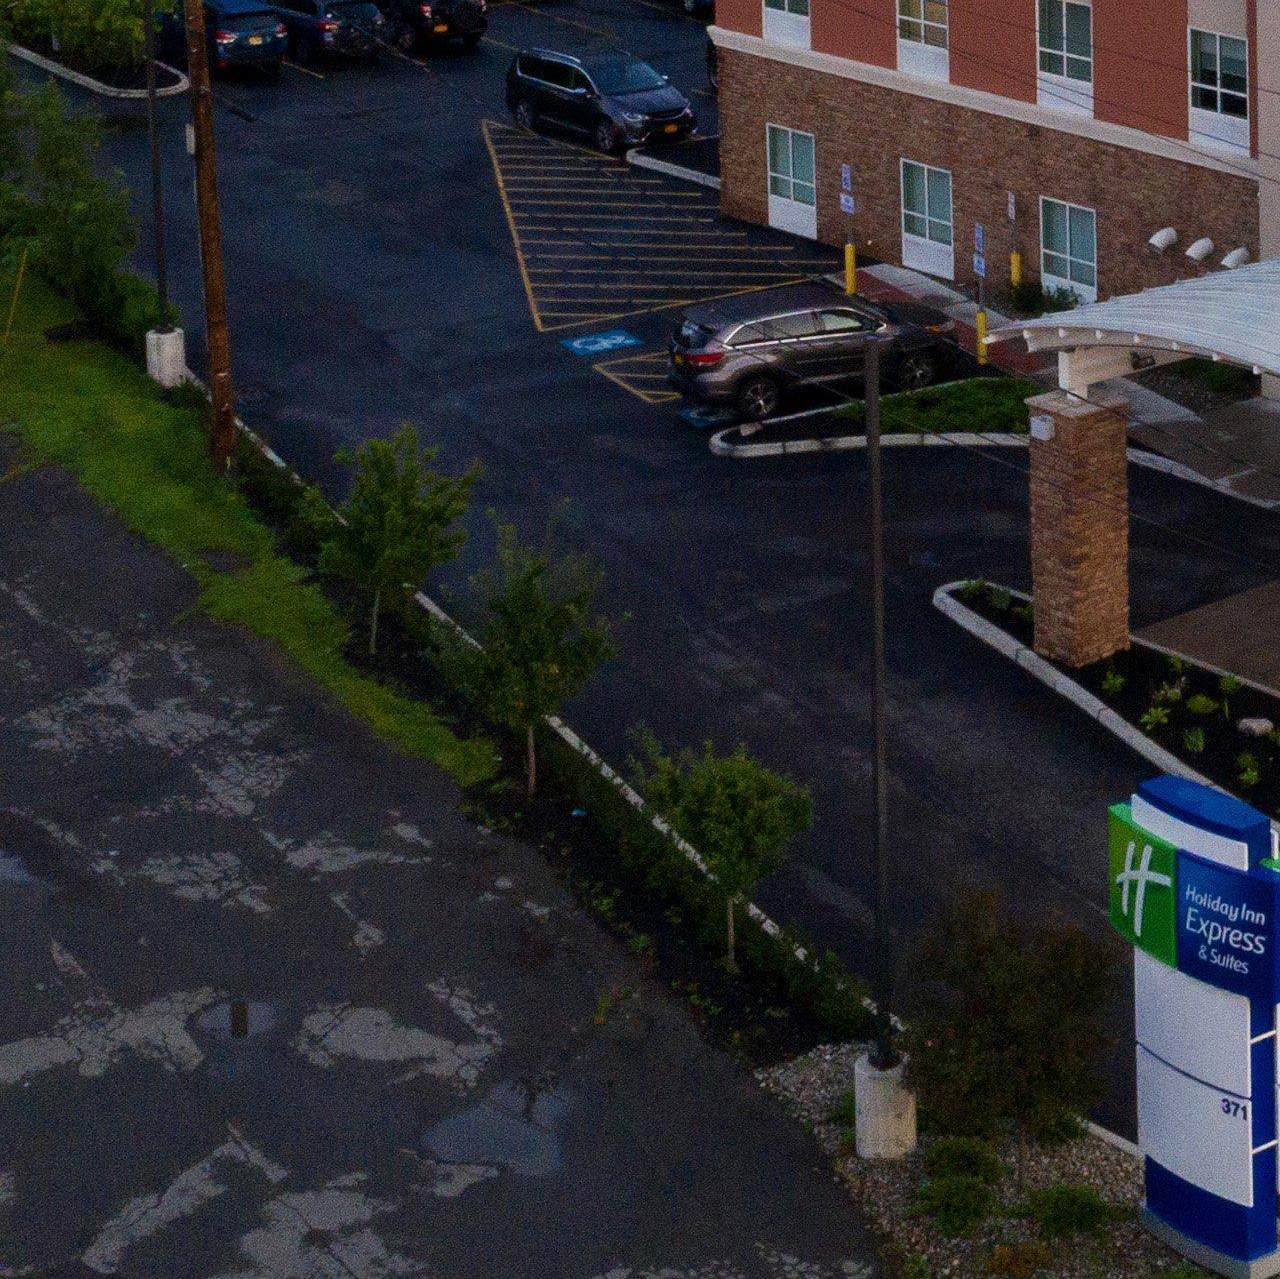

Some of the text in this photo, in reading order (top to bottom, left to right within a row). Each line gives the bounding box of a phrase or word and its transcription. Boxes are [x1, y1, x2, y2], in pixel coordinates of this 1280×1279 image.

[1186, 884, 1266, 926] Holiday Inn
[1186, 906, 1266, 954] Express
[1198, 944, 1249, 974] & Suites
[1221, 1097, 1248, 1121] 371
